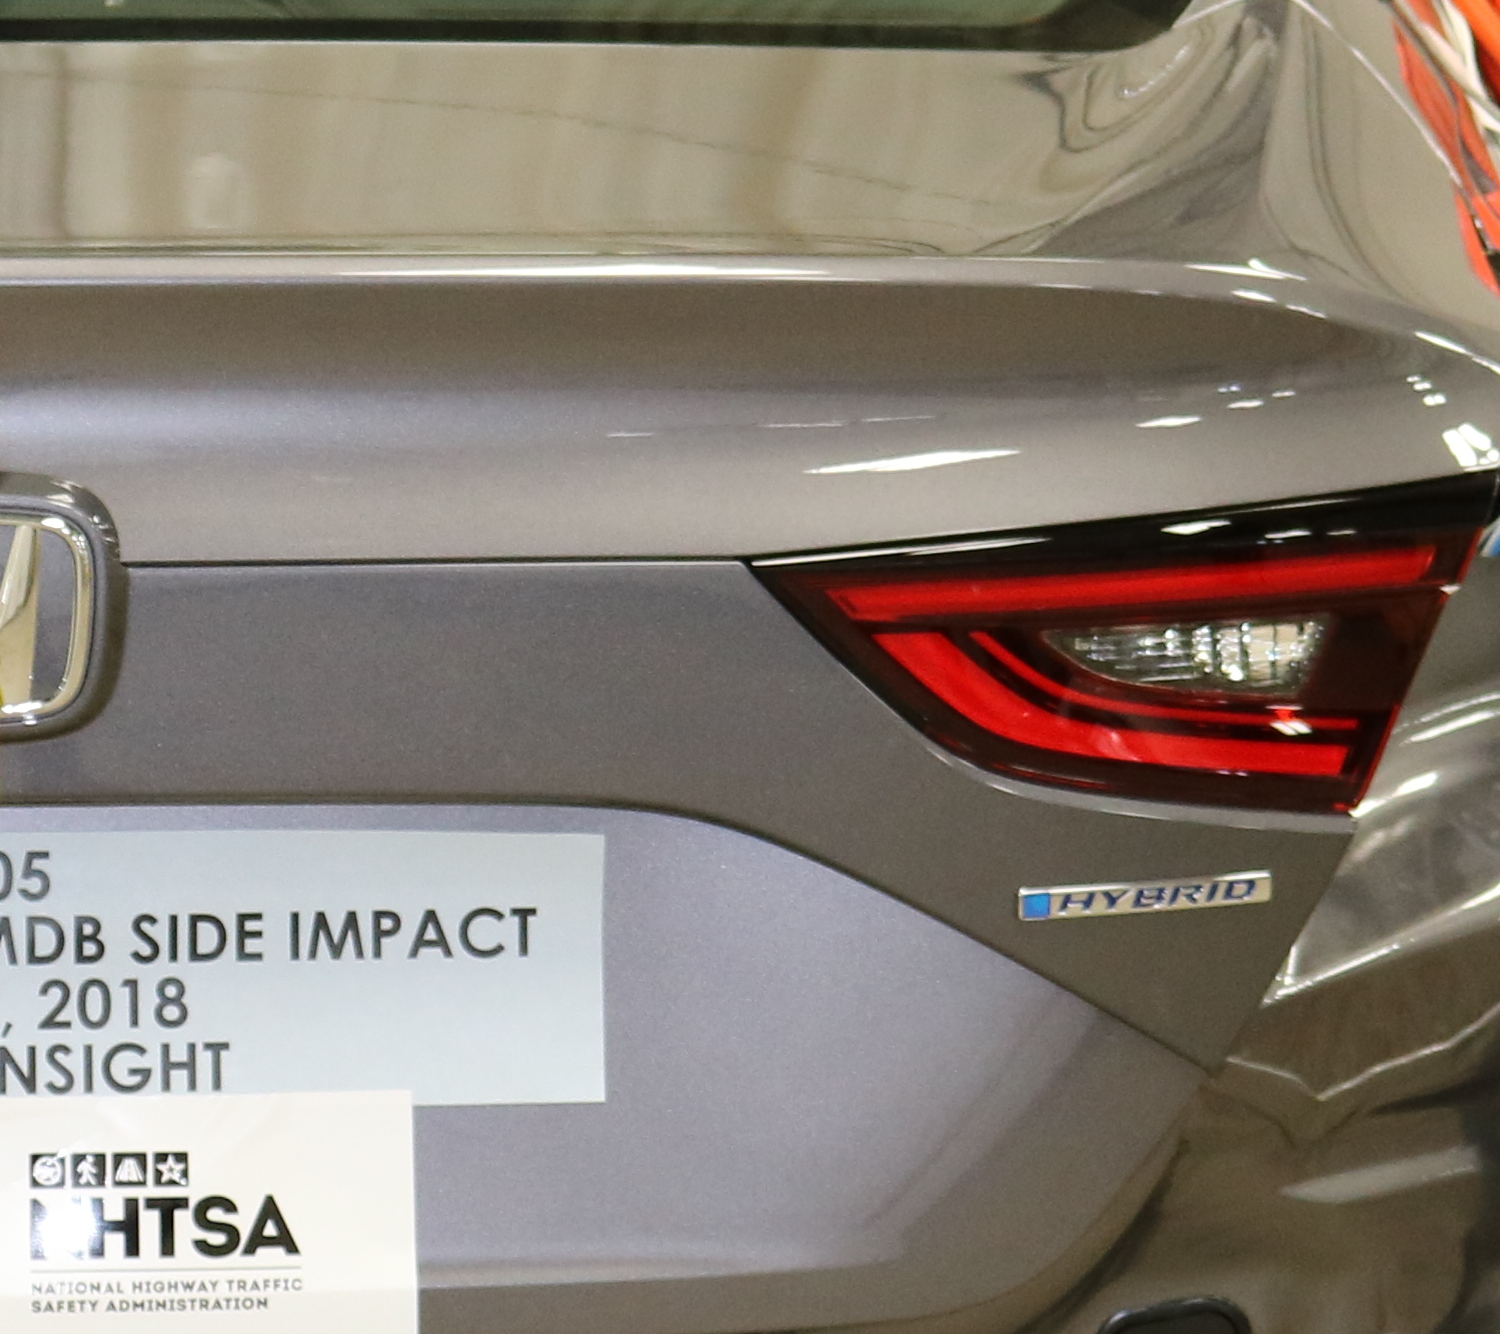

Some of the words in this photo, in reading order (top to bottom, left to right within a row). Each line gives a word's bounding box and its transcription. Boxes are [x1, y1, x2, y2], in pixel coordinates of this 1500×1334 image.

[1057, 879, 1256, 916] HYBRID
[130, 912, 264, 965] SIDE
[290, 907, 538, 961] IMPACT
[38, 976, 189, 1030] 2018
[30, 1281, 124, 1295] NATIONAL
[131, 1279, 219, 1294] HIGHWAY
[226, 1277, 303, 1291] TRAFFIC
[30, 1299, 98, 1313] SAFETY
[104, 1296, 268, 1312] ADMINISTRATION
